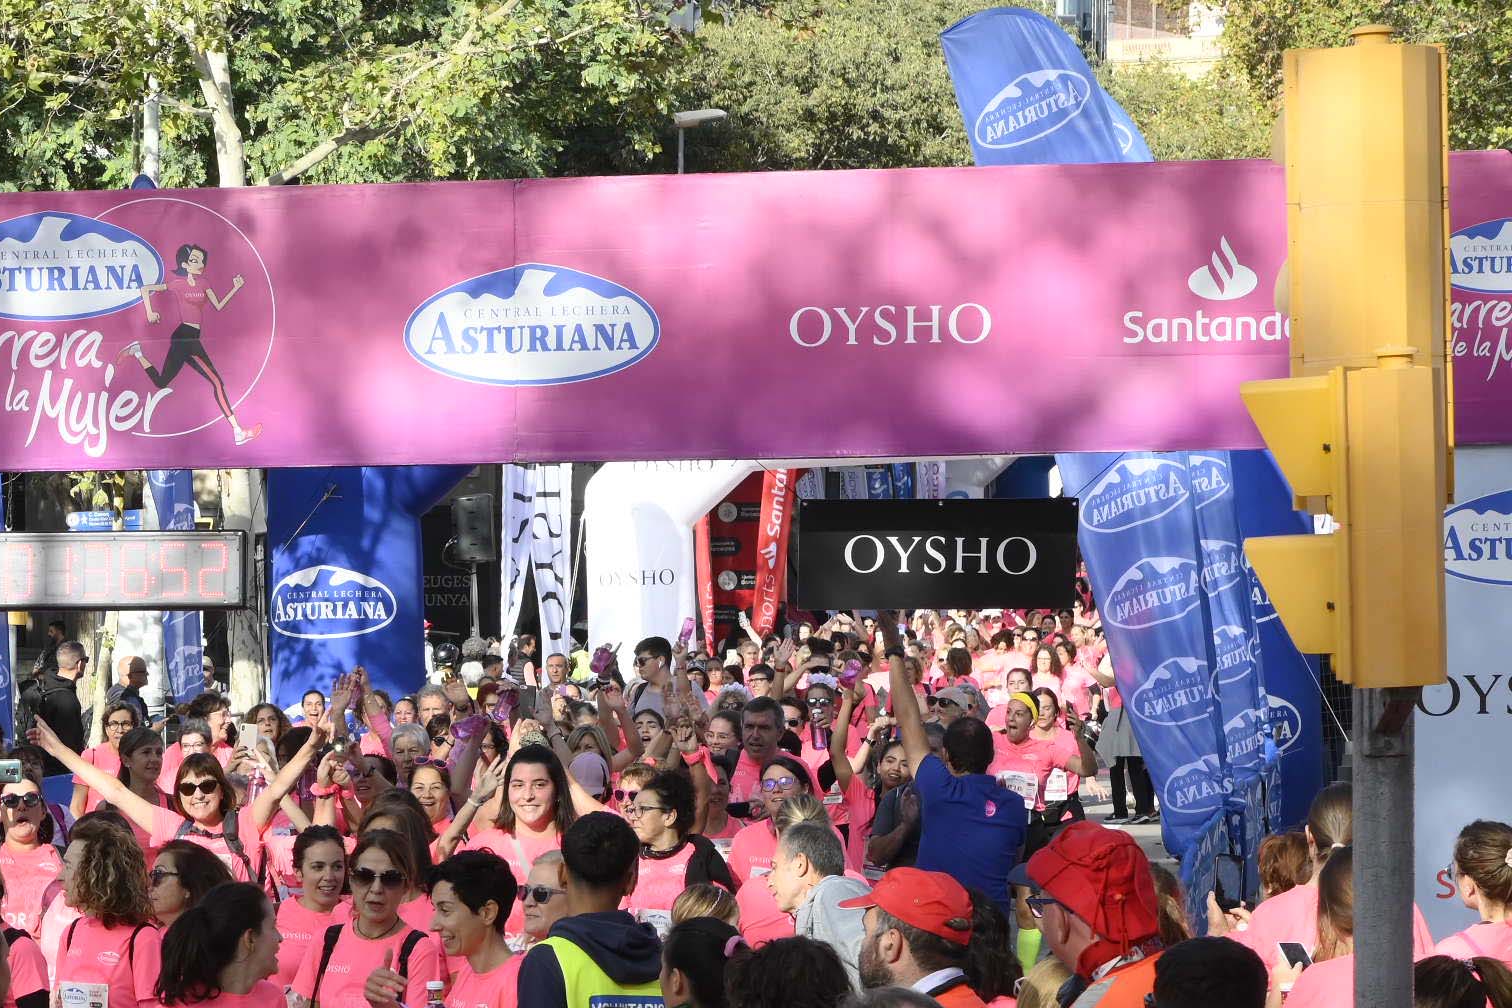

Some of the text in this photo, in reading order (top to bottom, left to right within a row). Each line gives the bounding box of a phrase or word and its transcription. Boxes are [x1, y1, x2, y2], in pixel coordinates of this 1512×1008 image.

[66, 247, 139, 260] LECHERA
[464, 304, 632, 319] CENTRAL LECHERA
[790, 302, 993, 348] OYSHO
[1450, 299, 1512, 329] arre
[423, 311, 640, 356] ASTURIANA
[1474, 330, 1491, 357] la
[5, 371, 29, 412] la
[25, 365, 174, 458] Mujer
[844, 536, 1037, 575] OYSHO
[274, 594, 387, 623] ASTURIANA
[333, 589, 383, 599] LECHERA
